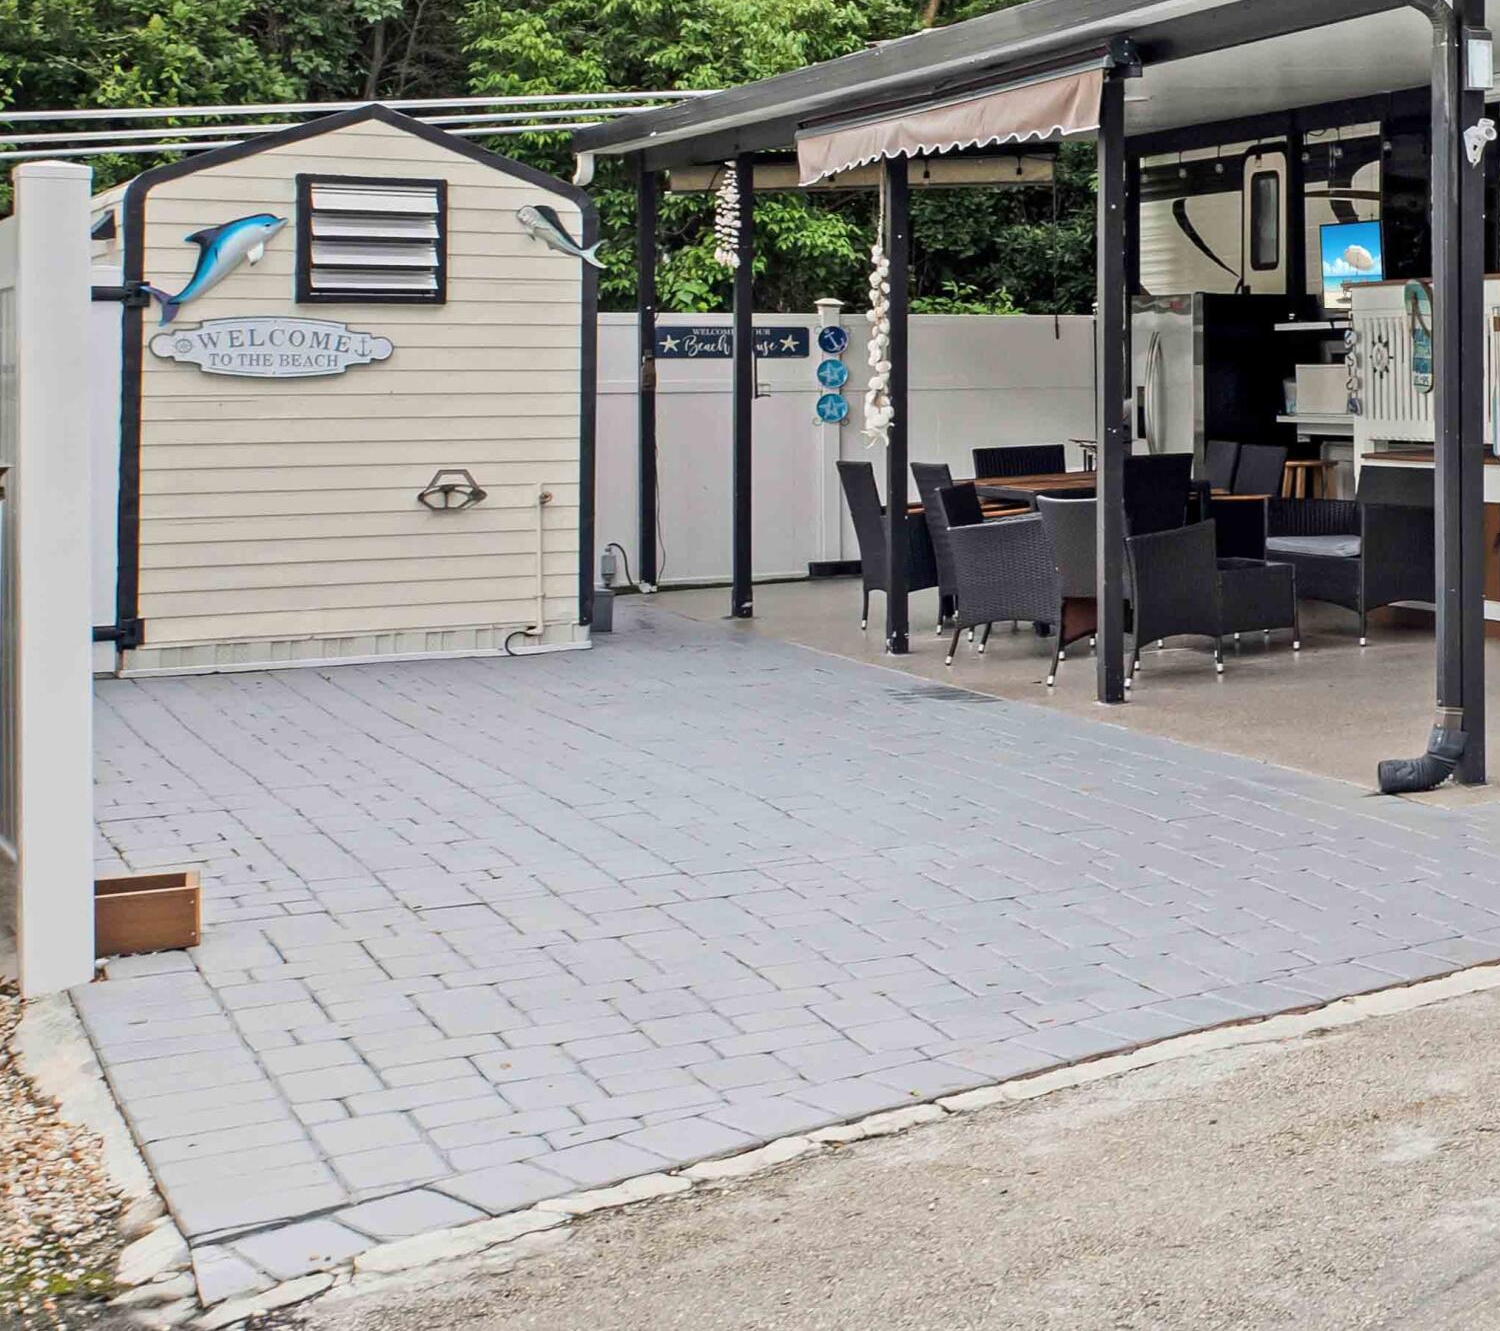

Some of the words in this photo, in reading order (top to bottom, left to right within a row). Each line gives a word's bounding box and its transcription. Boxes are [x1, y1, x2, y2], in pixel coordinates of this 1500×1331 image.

[197, 328, 351, 354] WELCOME
[682, 333, 731, 357] Beach
[756, 340, 778, 356] use
[208, 353, 233, 367] TO
[236, 353, 274, 367] THE
[278, 353, 339, 368] BEACH
